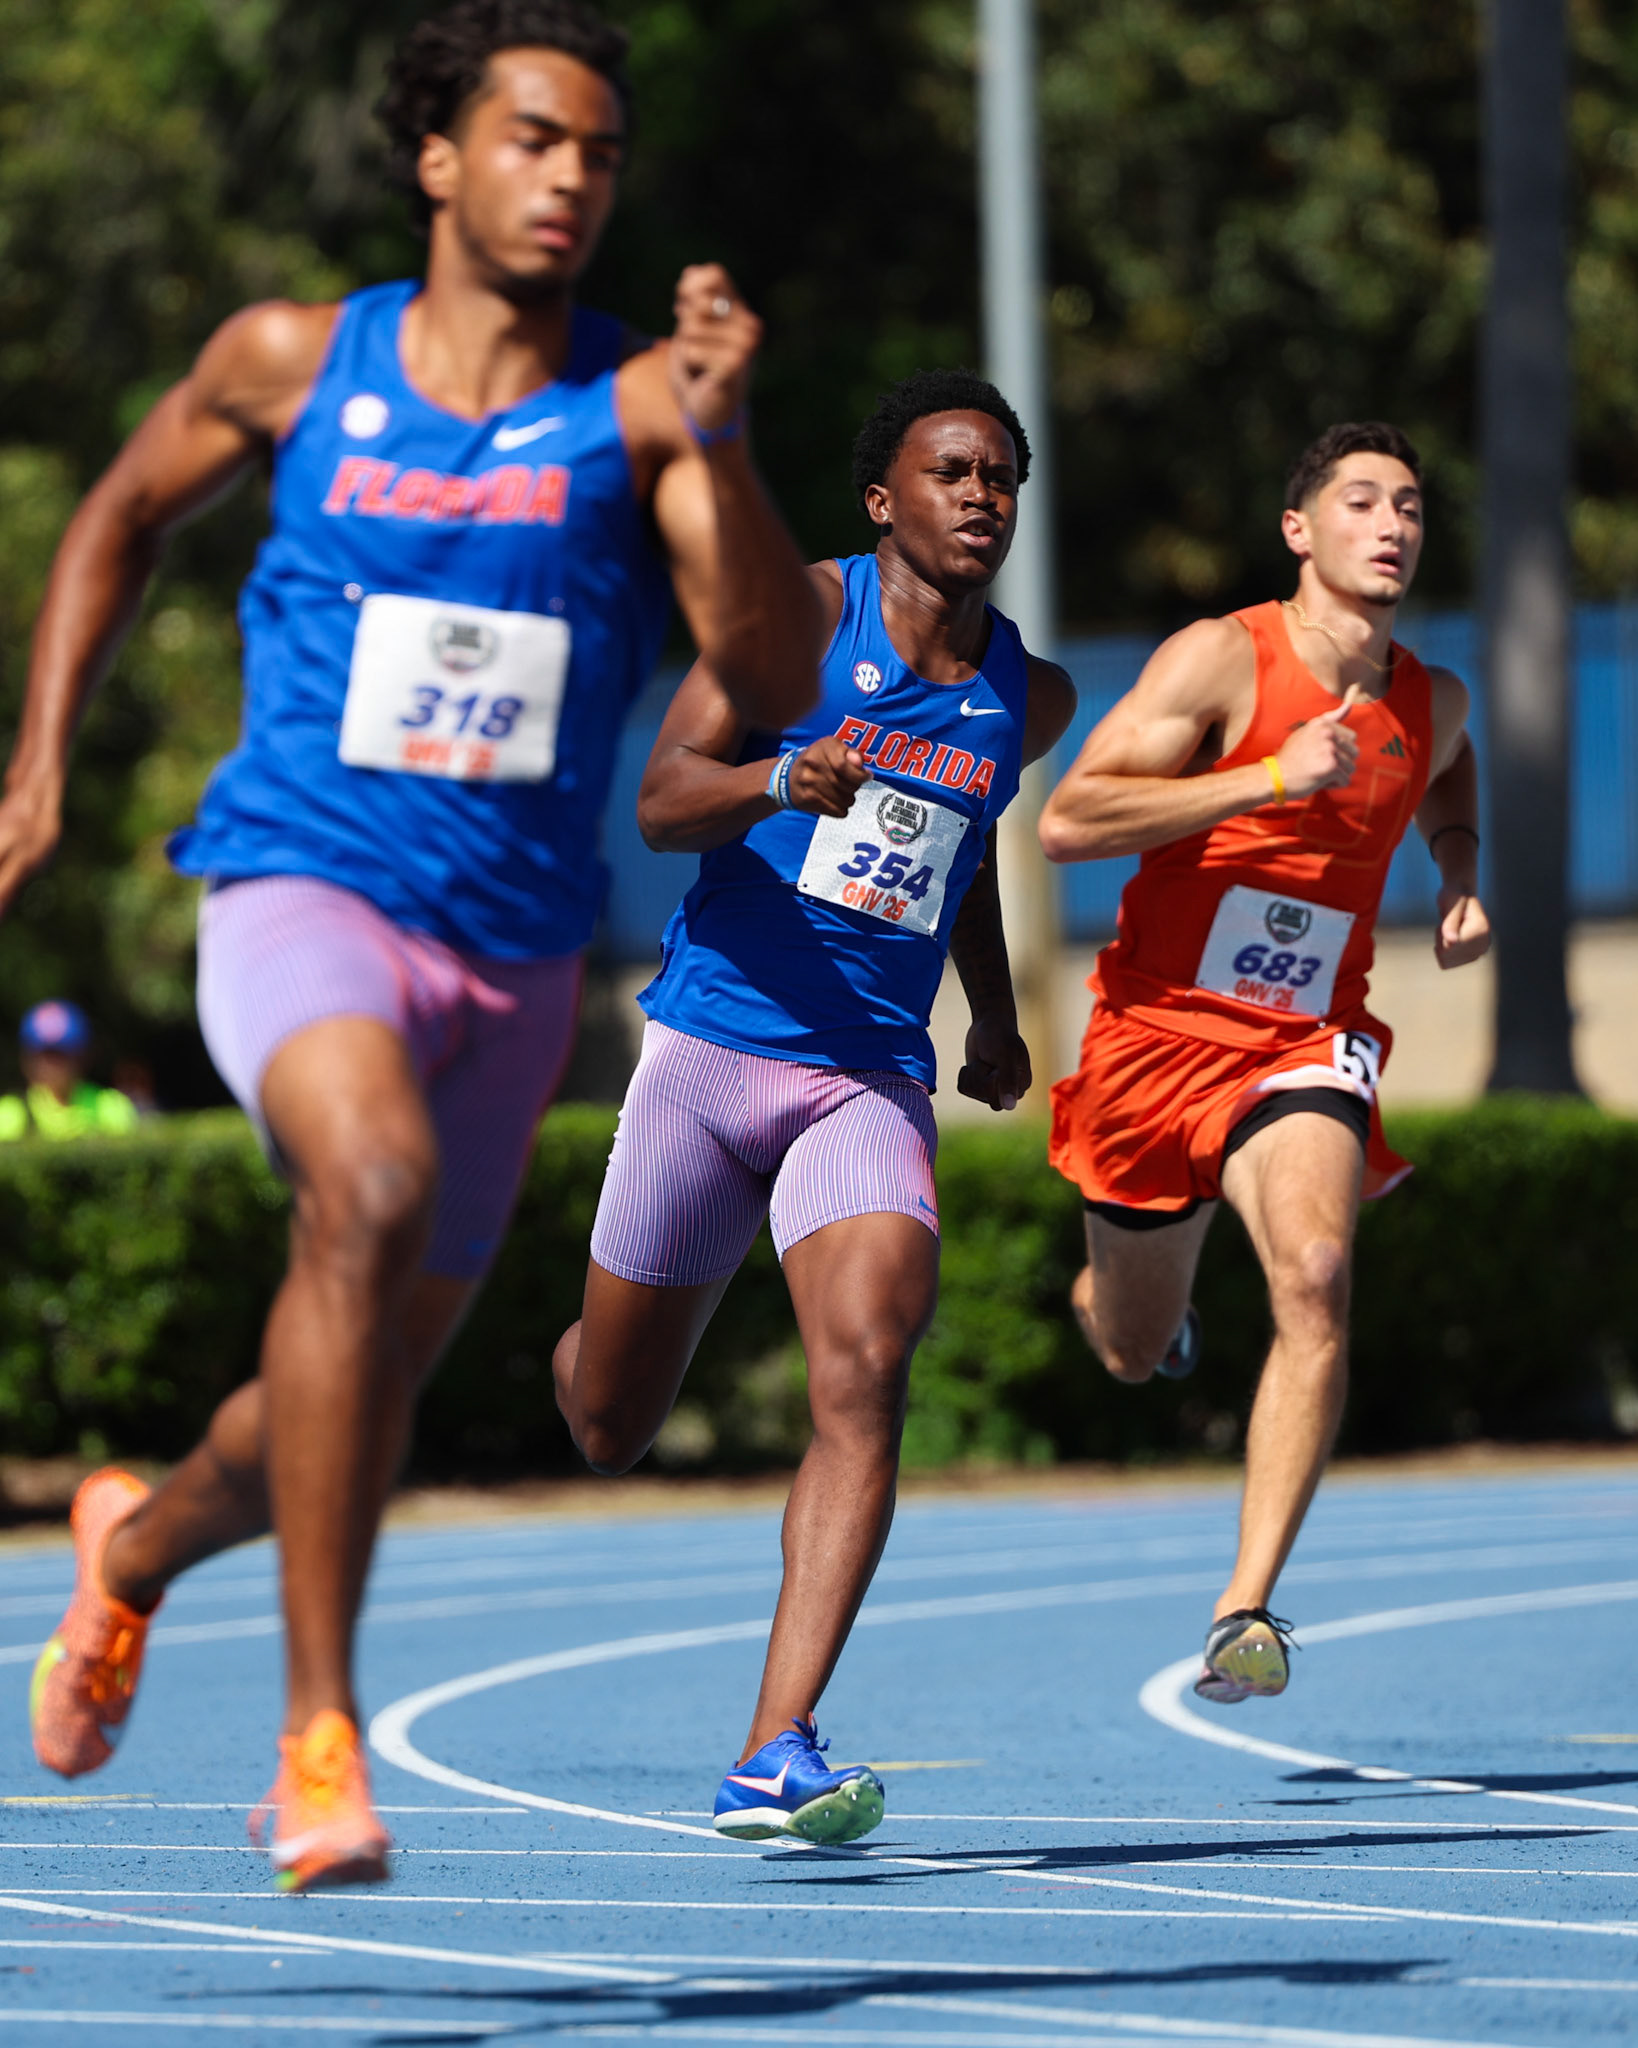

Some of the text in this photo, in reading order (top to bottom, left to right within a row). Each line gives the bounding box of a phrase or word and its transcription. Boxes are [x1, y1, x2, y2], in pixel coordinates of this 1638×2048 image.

[322, 455, 572, 526] FLORIDA
[856, 663, 881, 692] SEC
[401, 685, 525, 739] 318
[834, 715, 996, 799] FLORIDA
[838, 842, 934, 901] 354
[842, 881, 908, 921] GNV '25
[1233, 944, 1322, 987] 683
[1234, 978, 1271, 1002] GNV
[1342, 1030, 1371, 1085] 5
